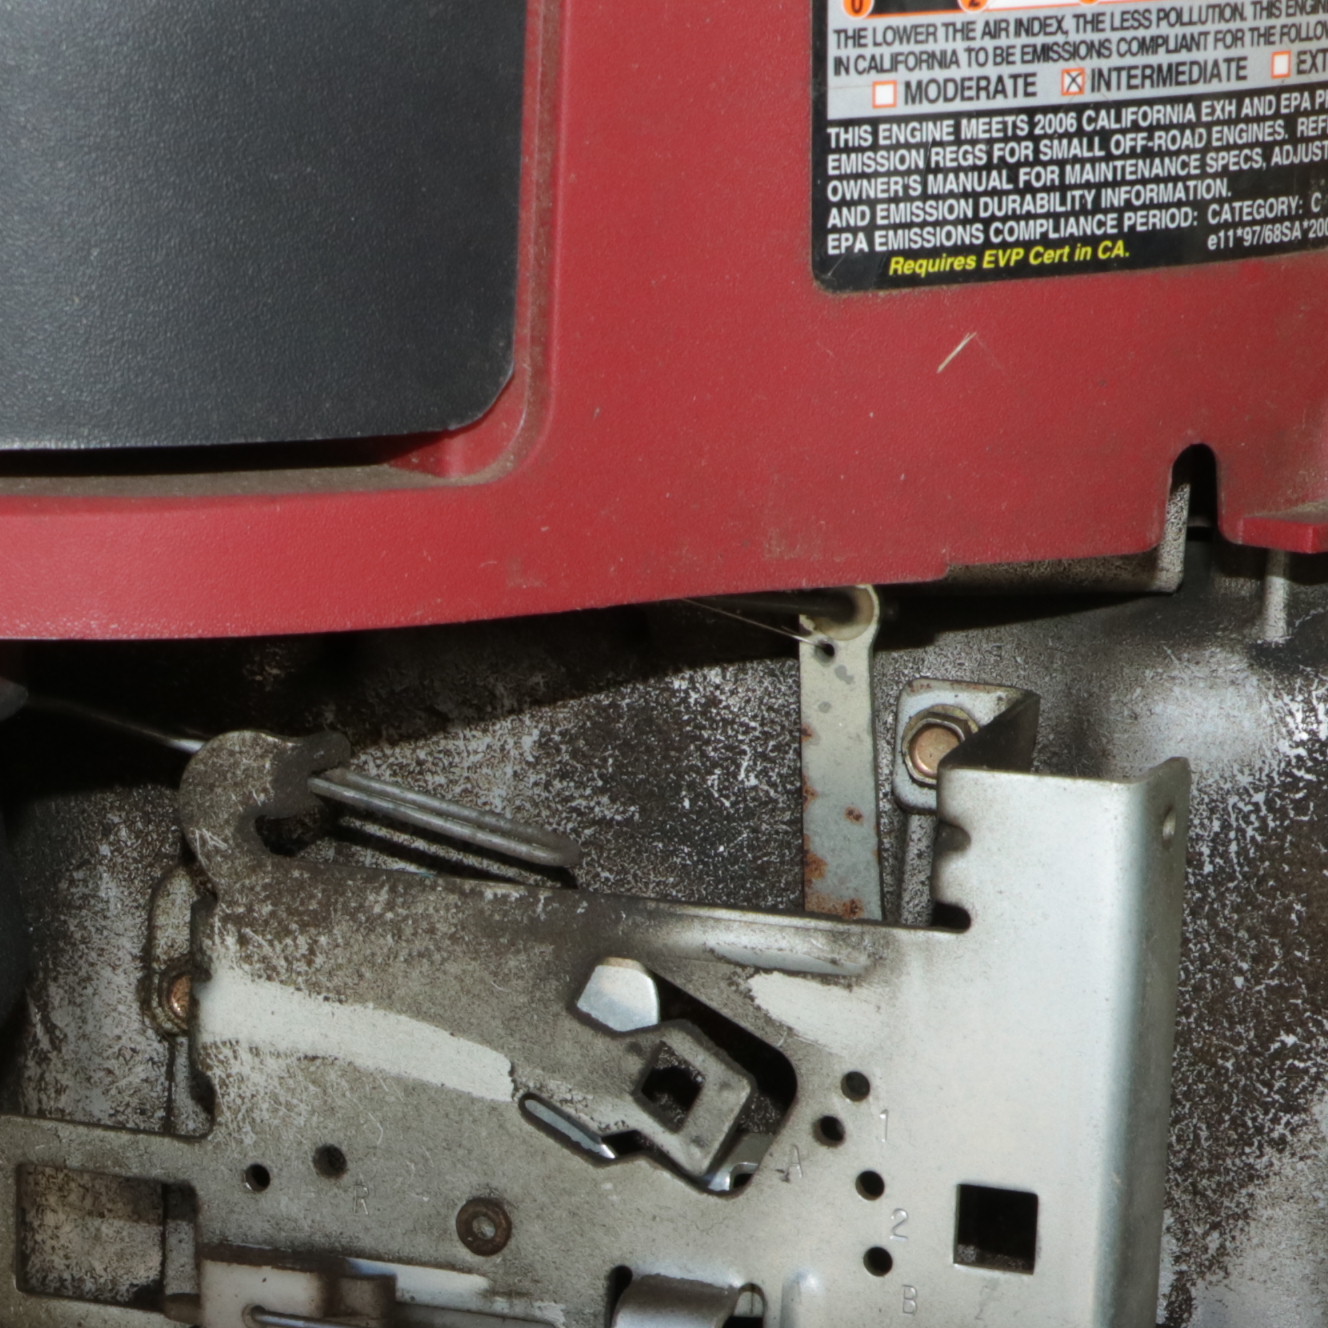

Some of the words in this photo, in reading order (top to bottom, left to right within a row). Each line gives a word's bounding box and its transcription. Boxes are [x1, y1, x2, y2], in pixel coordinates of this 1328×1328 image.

[833, 28, 868, 49] THE
[872, 23, 938, 47] LOWER
[941, 21, 977, 43] THE
[981, 18, 1010, 41] AIR
[1014, 15, 1069, 40] INDEX,
[1072, 12, 1107, 34] THE
[1110, 9, 1152, 31] LESS
[1156, 2, 1248, 29] POLLUTION.
[1250, 0, 1282, 21] THIS
[834, 55, 850, 76] IN
[854, 49, 961, 76] CALIFORNIA
[965, 46, 989, 69] TO
[993, 45, 1016, 66] BE
[1021, 38, 1112, 65] EMISSIONS
[1116, 31, 1210, 58] COMPLIANT
[1214, 28, 1245, 49] FOR
[1248, 25, 1276, 46] THE
[1090, 56, 1249, 93] INTERMEDIATE
[1296, 48, 1328, 75] EXT
[904, 72, 1038, 106] MODERATE
[827, 124, 872, 149] THIS
[878, 120, 955, 146] ENGINE
[960, 114, 1029, 140] MEETS
[1034, 112, 1077, 135] 2006
[1082, 102, 1196, 132] CALIFORNIA
[1201, 98, 1237, 122] EXH
[1241, 94, 1276, 119] AND
[1280, 91, 1312, 115] EPA
[1315, 88, 1328, 110] P
[827, 148, 924, 176] EMISSION
[930, 143, 987, 169] REGS
[993, 141, 1034, 164] FOR
[1039, 136, 1105, 161] SMALL
[1110, 128, 1207, 156] OFF-ROAD
[1211, 119, 1288, 147] ENGINES.
[1297, 115, 1328, 138] REF
[827, 174, 922, 201] OWNER'S
[927, 169, 1014, 195] MANUAL
[1019, 165, 1060, 189] FOR
[1065, 154, 1201, 185] MAINTENANCE
[1205, 148, 1266, 174] SPECS,
[1271, 140, 1328, 167] ADJUST
[827, 205, 871, 229] AND
[876, 198, 973, 225] EMISSION
[979, 188, 1096, 218] DURABILITY
[1100, 177, 1232, 209] INFORMATION.
[827, 232, 869, 255] EPA
[874, 223, 985, 252] EMISSIONS
[989, 213, 1118, 244] COMPLIANCE
[1123, 206, 1198, 233] PERIOD:
[1207, 194, 1303, 225] CATEGORY:
[1311, 192, 1322, 213] C
[889, 253, 977, 278] Requires
[982, 248, 1024, 269] EVP
[1028, 244, 1070, 265] Cert
[1074, 243, 1092, 261] in
[1097, 239, 1130, 260] CA.
[889, 1207, 910, 1241] 2
[902, 1284, 918, 1315] B
